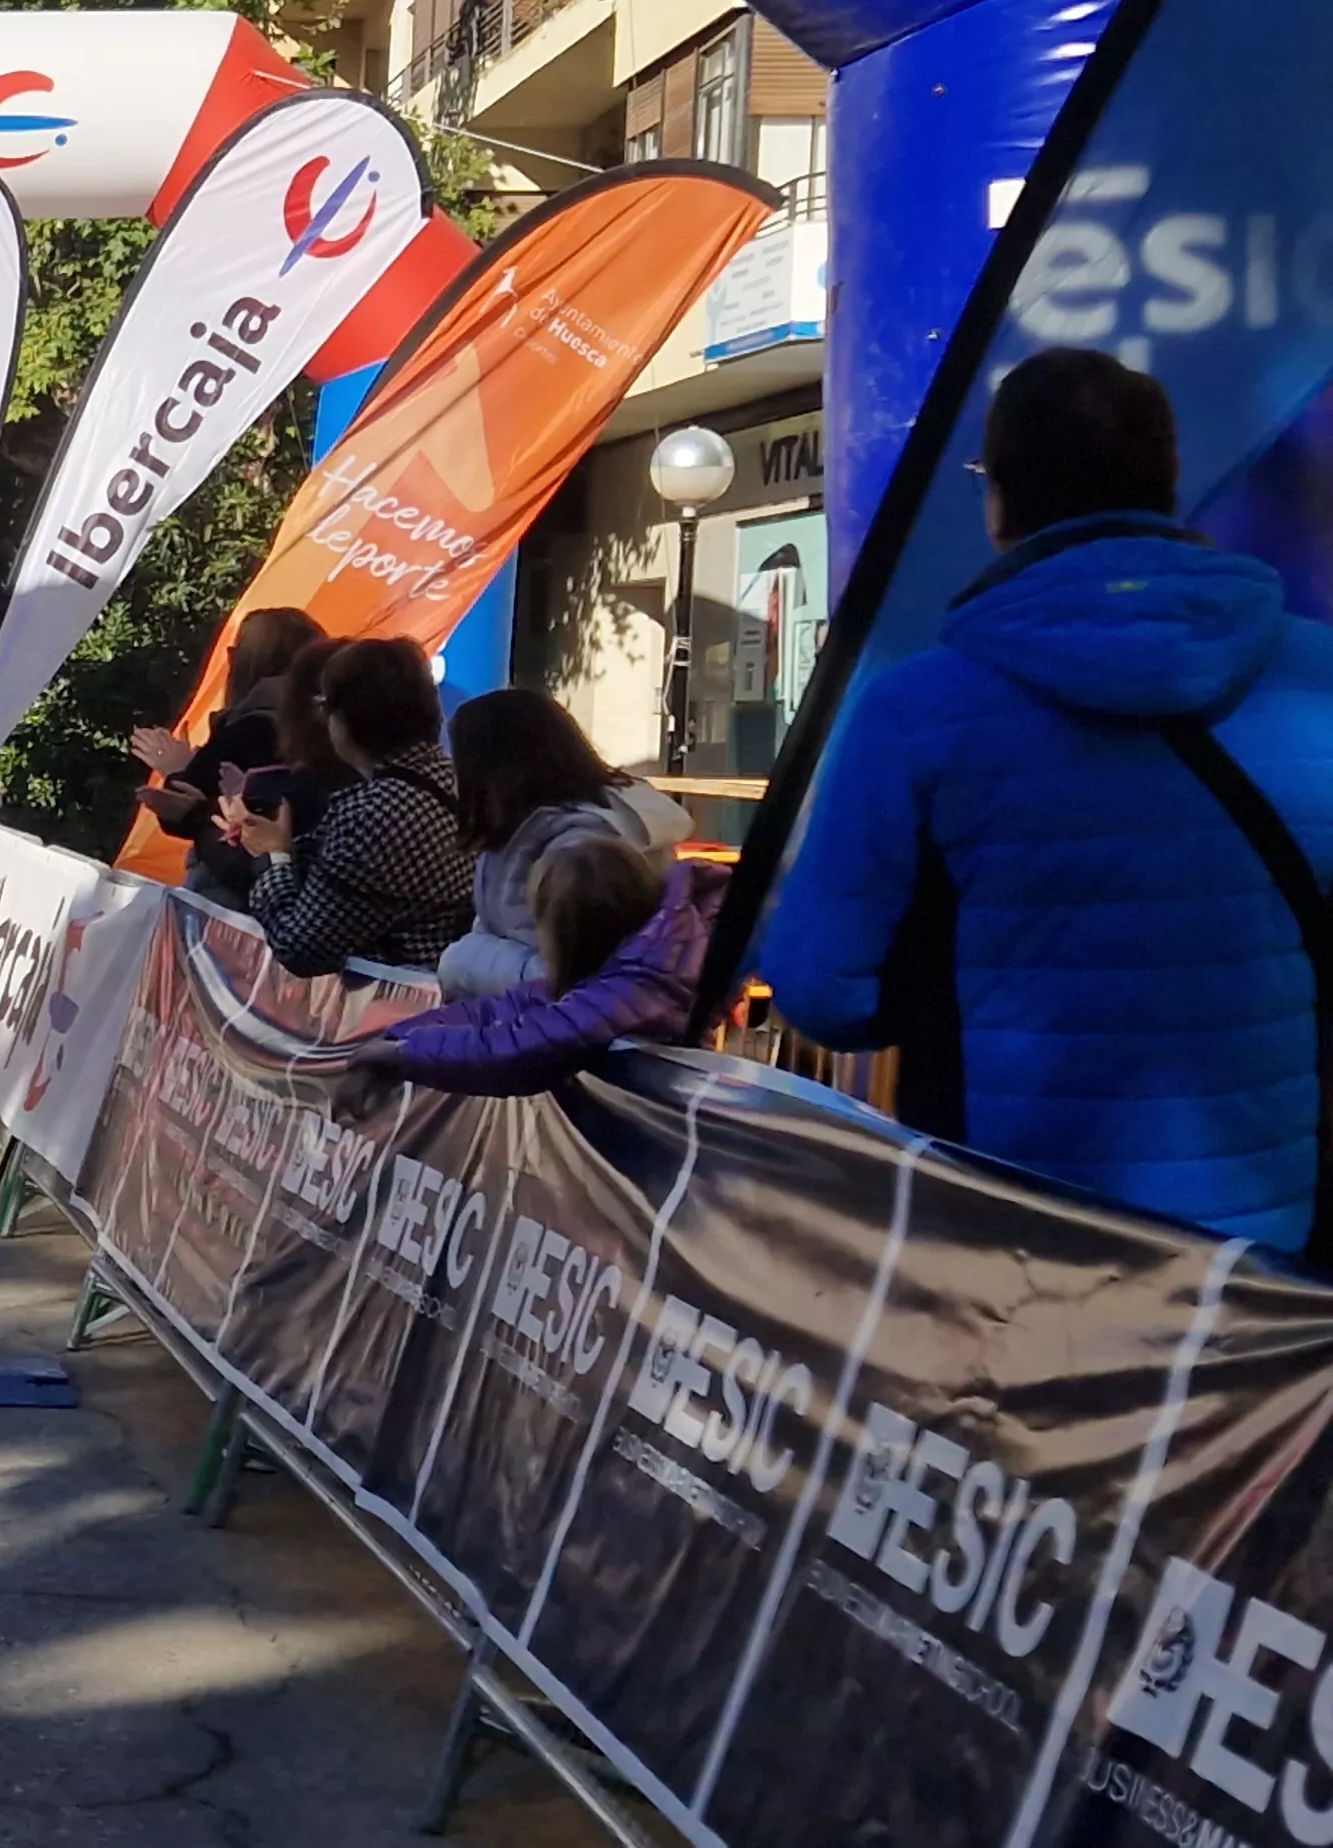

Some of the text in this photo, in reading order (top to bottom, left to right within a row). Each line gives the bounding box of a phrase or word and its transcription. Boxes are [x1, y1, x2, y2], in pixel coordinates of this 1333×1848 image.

[548, 318, 608, 369] Huesca
[46, 295, 281, 590] Ibercaja
[318, 455, 489, 568] Hacemos
[300, 1117, 376, 1224] ESIC
[517, 1227, 622, 1375] ESIC
[663, 1313, 814, 1493] ESIC
[873, 1428, 1076, 1657] ESIC
